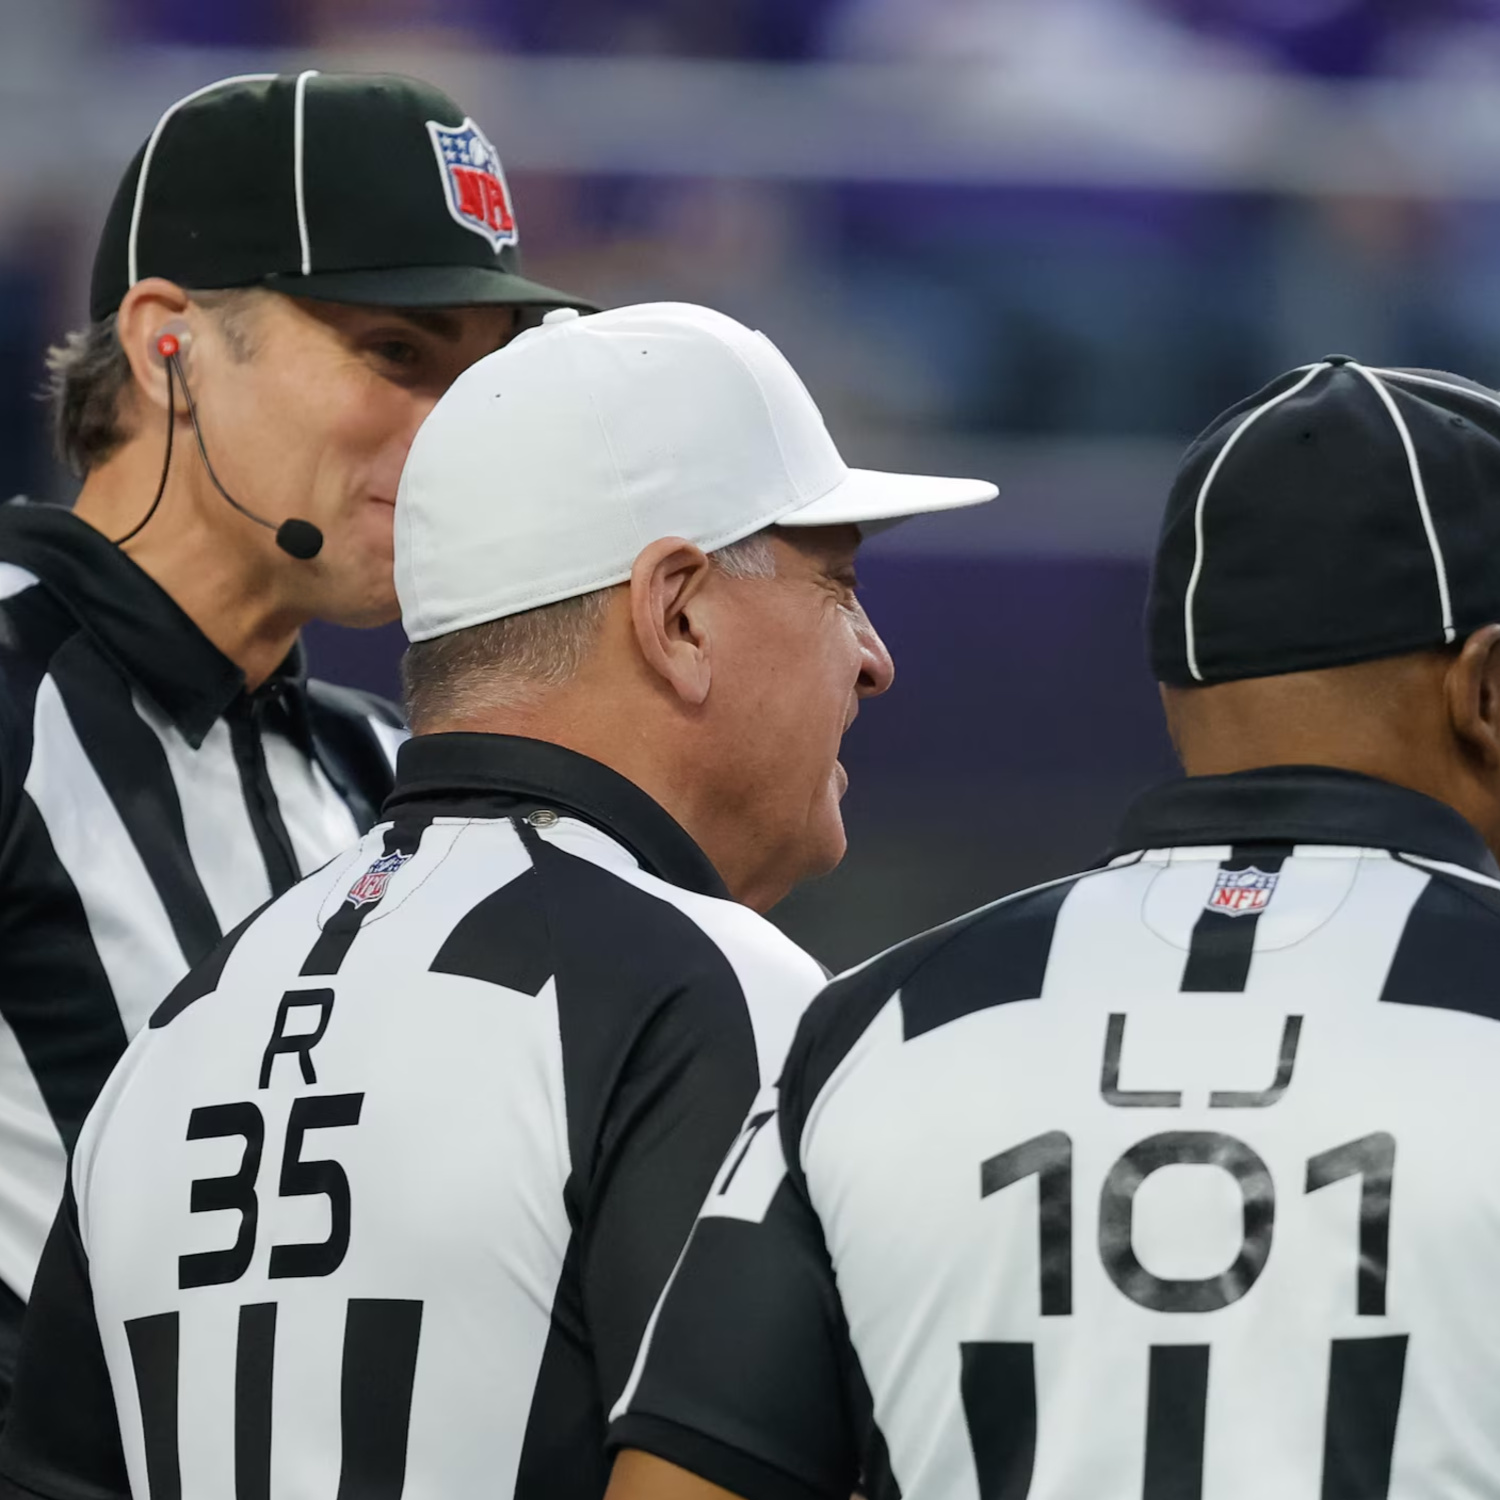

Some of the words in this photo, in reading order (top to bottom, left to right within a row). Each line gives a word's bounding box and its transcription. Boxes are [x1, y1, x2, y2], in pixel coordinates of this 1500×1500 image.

[451, 166, 515, 232] NFL
[349, 872, 388, 899] NFL
[1214, 887, 1264, 909] NFL
[258, 987, 336, 1090] R
[1100, 1012, 1304, 1108] LJ
[178, 1091, 366, 1290] 35
[980, 1130, 1397, 1317] 101
